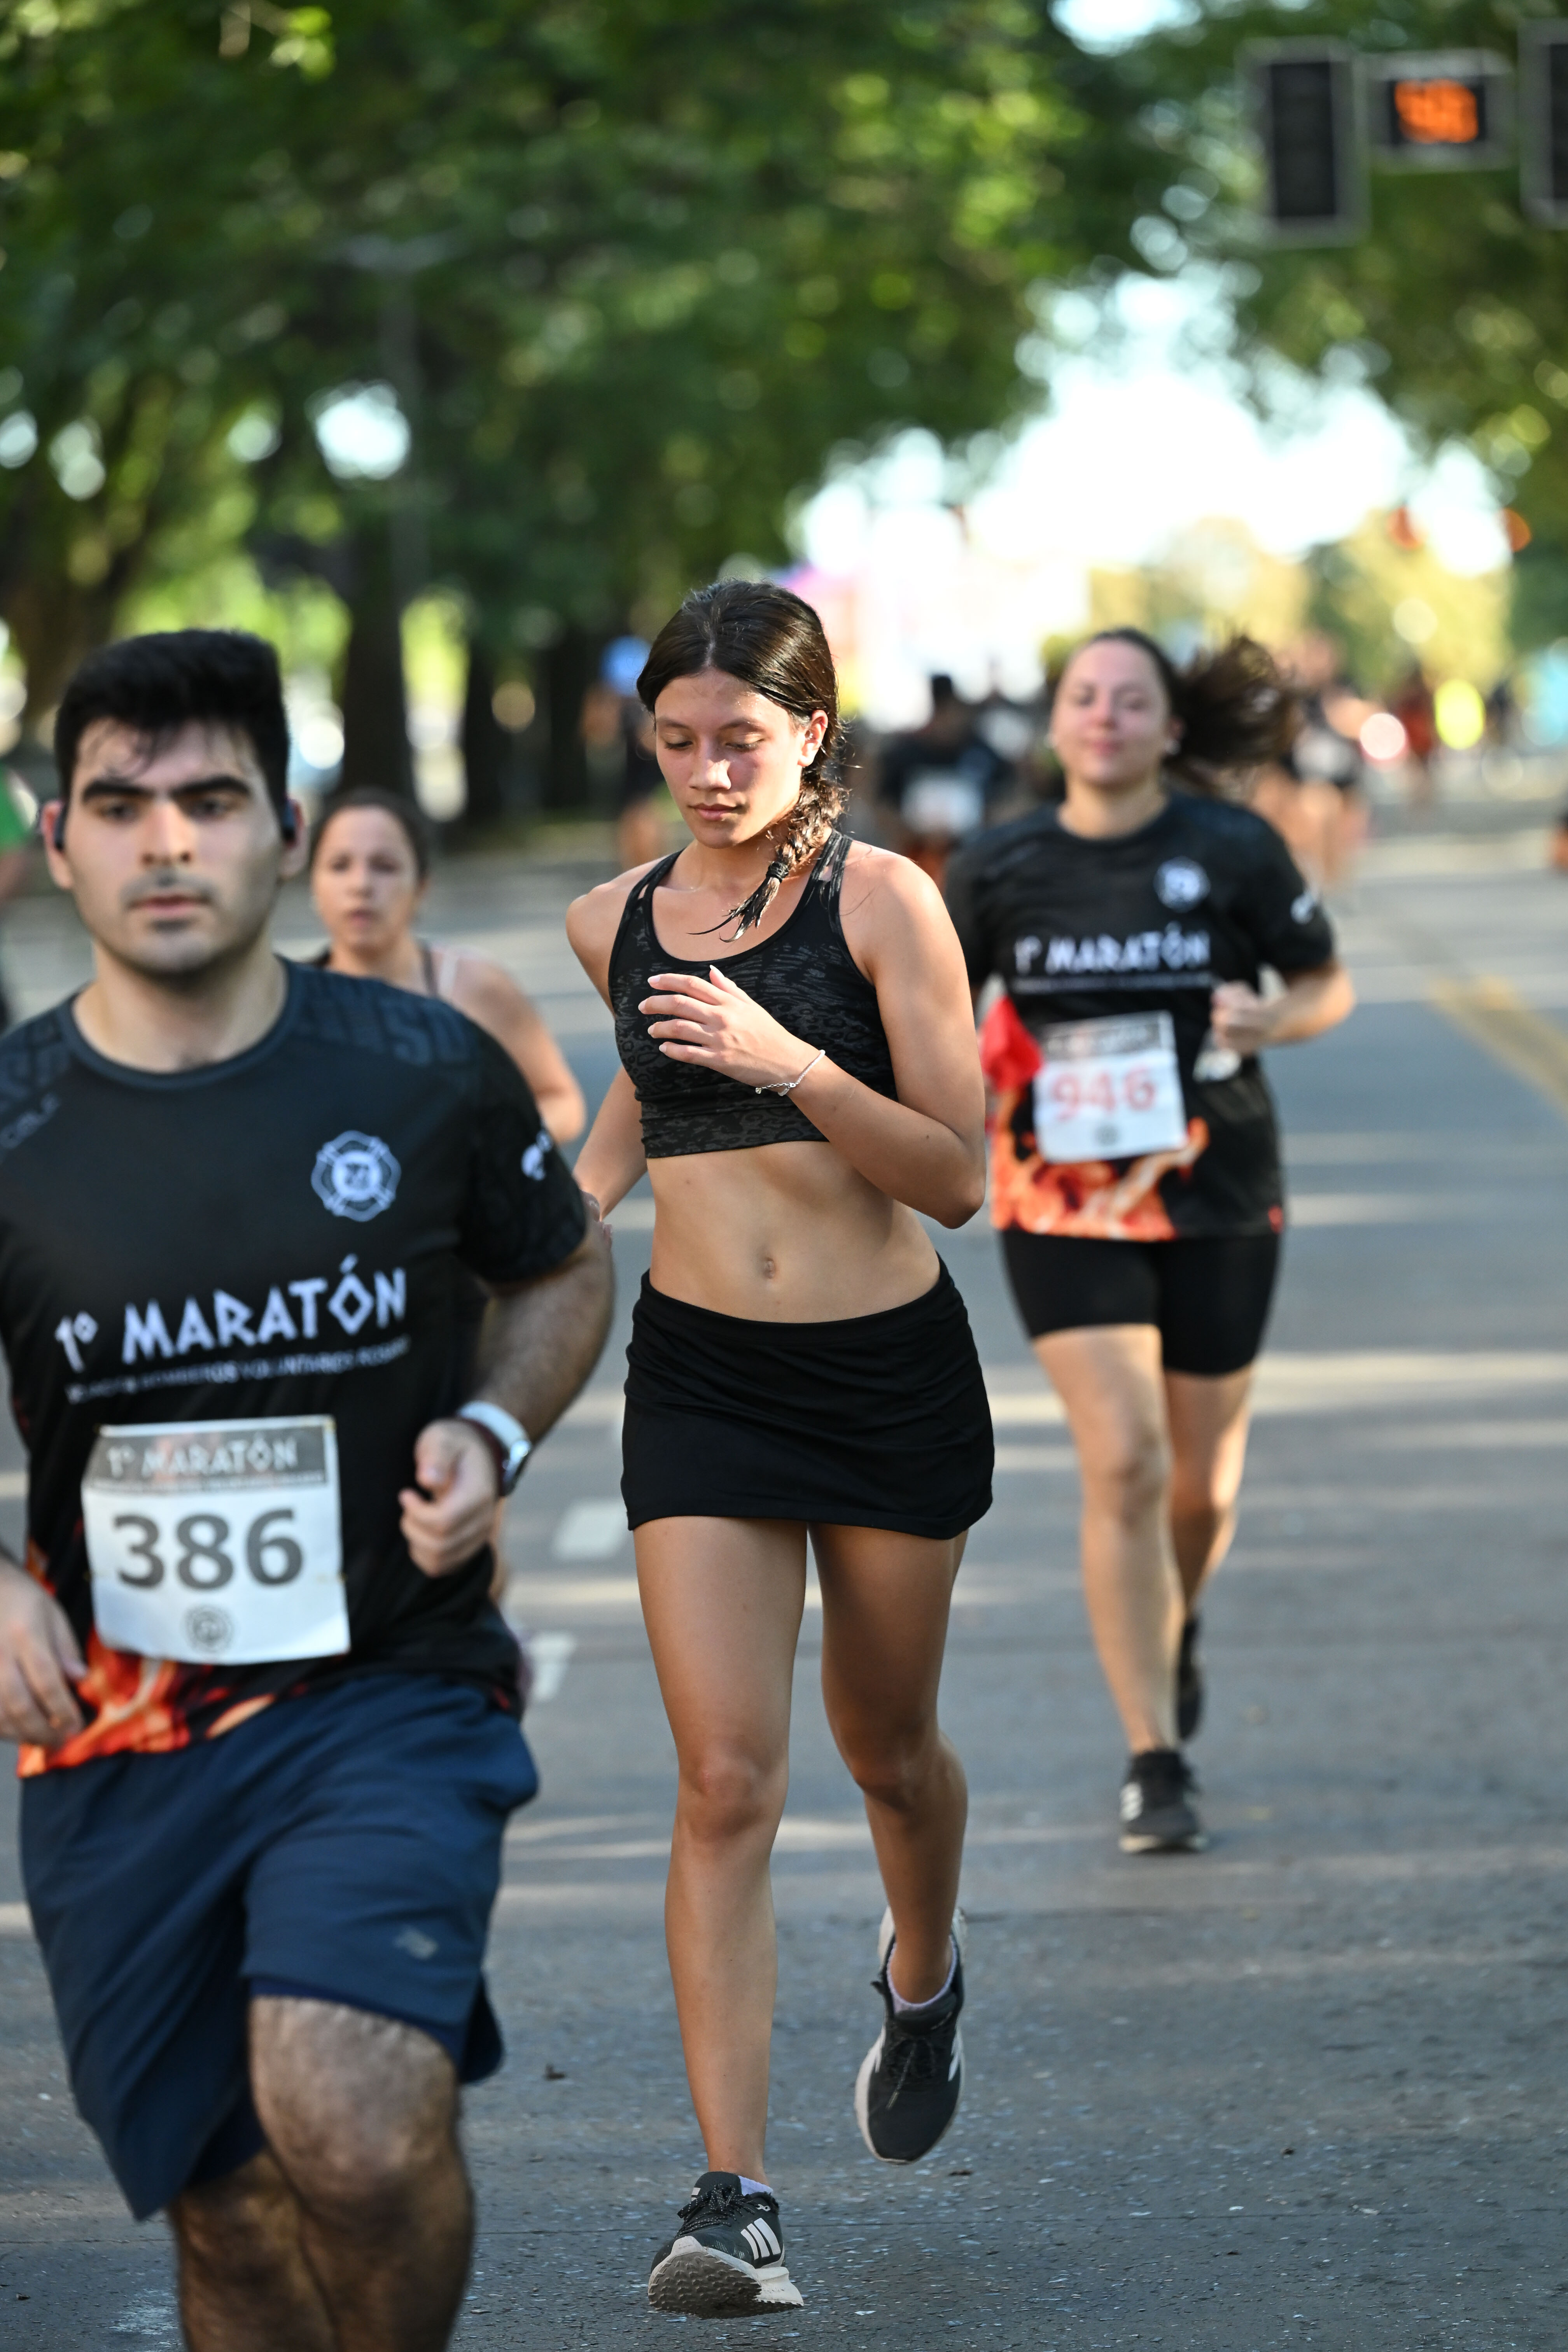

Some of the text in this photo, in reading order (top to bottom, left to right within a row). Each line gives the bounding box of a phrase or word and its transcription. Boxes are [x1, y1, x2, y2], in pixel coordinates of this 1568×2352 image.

[1045, 922, 1210, 974] MARATÓN
[1052, 1066, 1157, 1122] 946
[122, 1253, 406, 1365] MARATÓN
[141, 1433, 297, 1477] MARATÓN
[114, 1508, 303, 1591] 386
